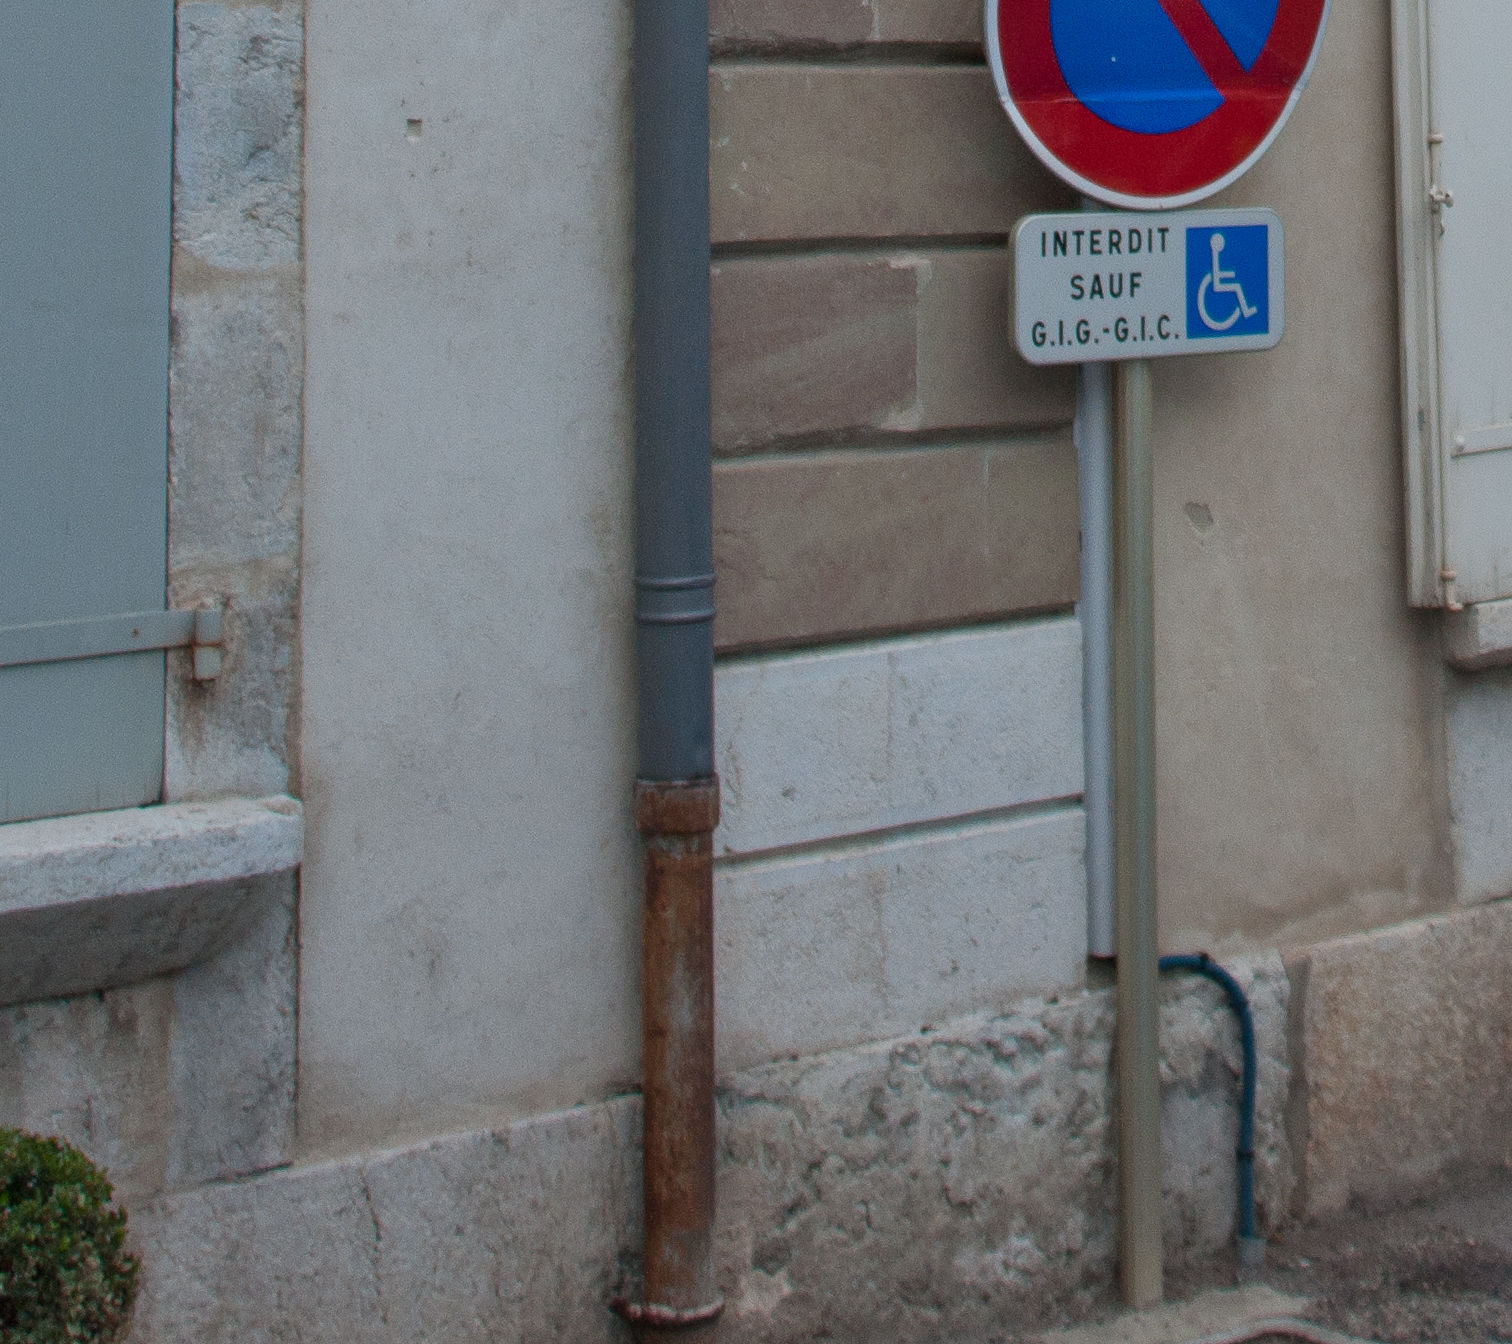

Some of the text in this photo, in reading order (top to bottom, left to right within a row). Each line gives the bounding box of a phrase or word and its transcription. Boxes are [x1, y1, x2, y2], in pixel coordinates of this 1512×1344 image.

[1041, 227, 1170, 257] INTERDIT
[1071, 272, 1142, 300] SAUF
[1031, 315, 1179, 347] G.I.G.-G.I.C.
